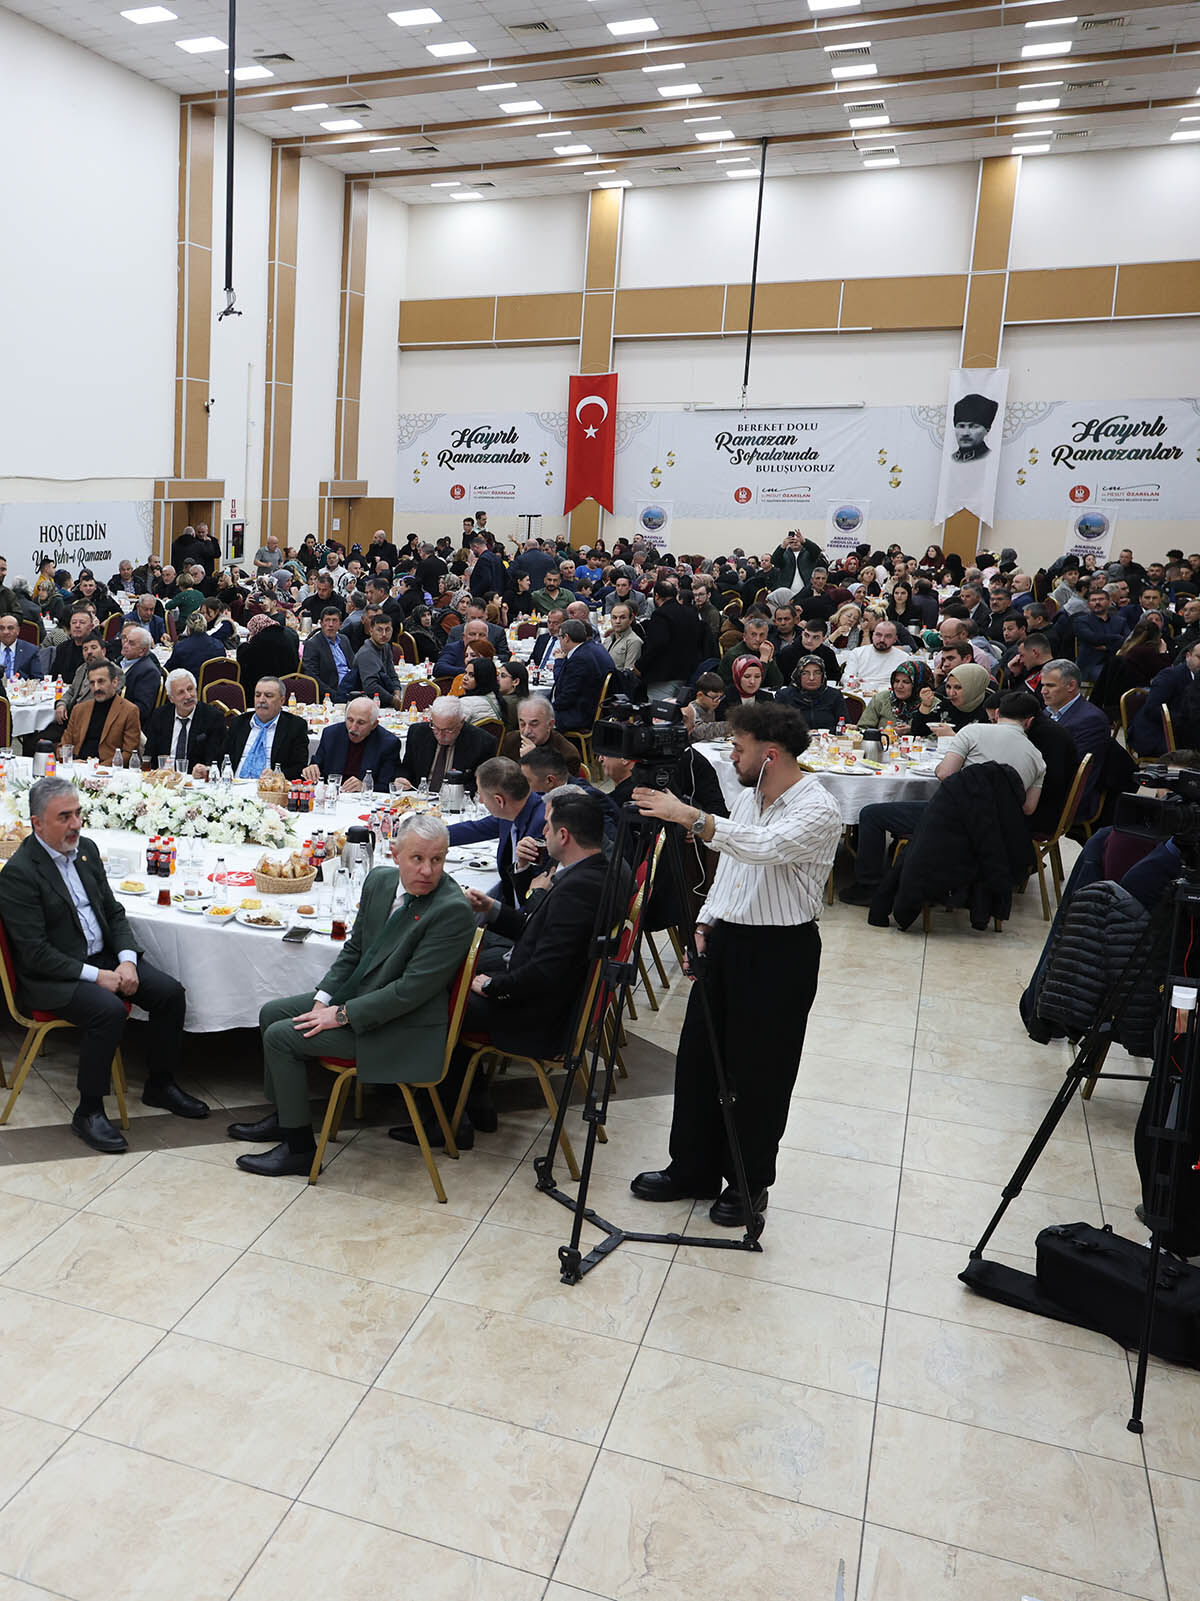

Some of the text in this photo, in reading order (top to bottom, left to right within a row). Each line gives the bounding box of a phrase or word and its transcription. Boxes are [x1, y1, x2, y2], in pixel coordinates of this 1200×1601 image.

[451, 425, 520, 451] Hayırlı
[737, 422, 818, 432] BEREKET DOLU
[1071, 415, 1168, 445] Hayırlı
[714, 431, 798, 454] Ramazan
[437, 448, 531, 471] Ramazanlar
[729, 446, 820, 466] Sofralarında
[1050, 442, 1184, 470] Ramazanlar
[755, 464, 835, 474] BULUŞUYORUZ
[39, 520, 107, 547] HOŞ GELDİN
[76, 547, 112, 569] Ramazan
